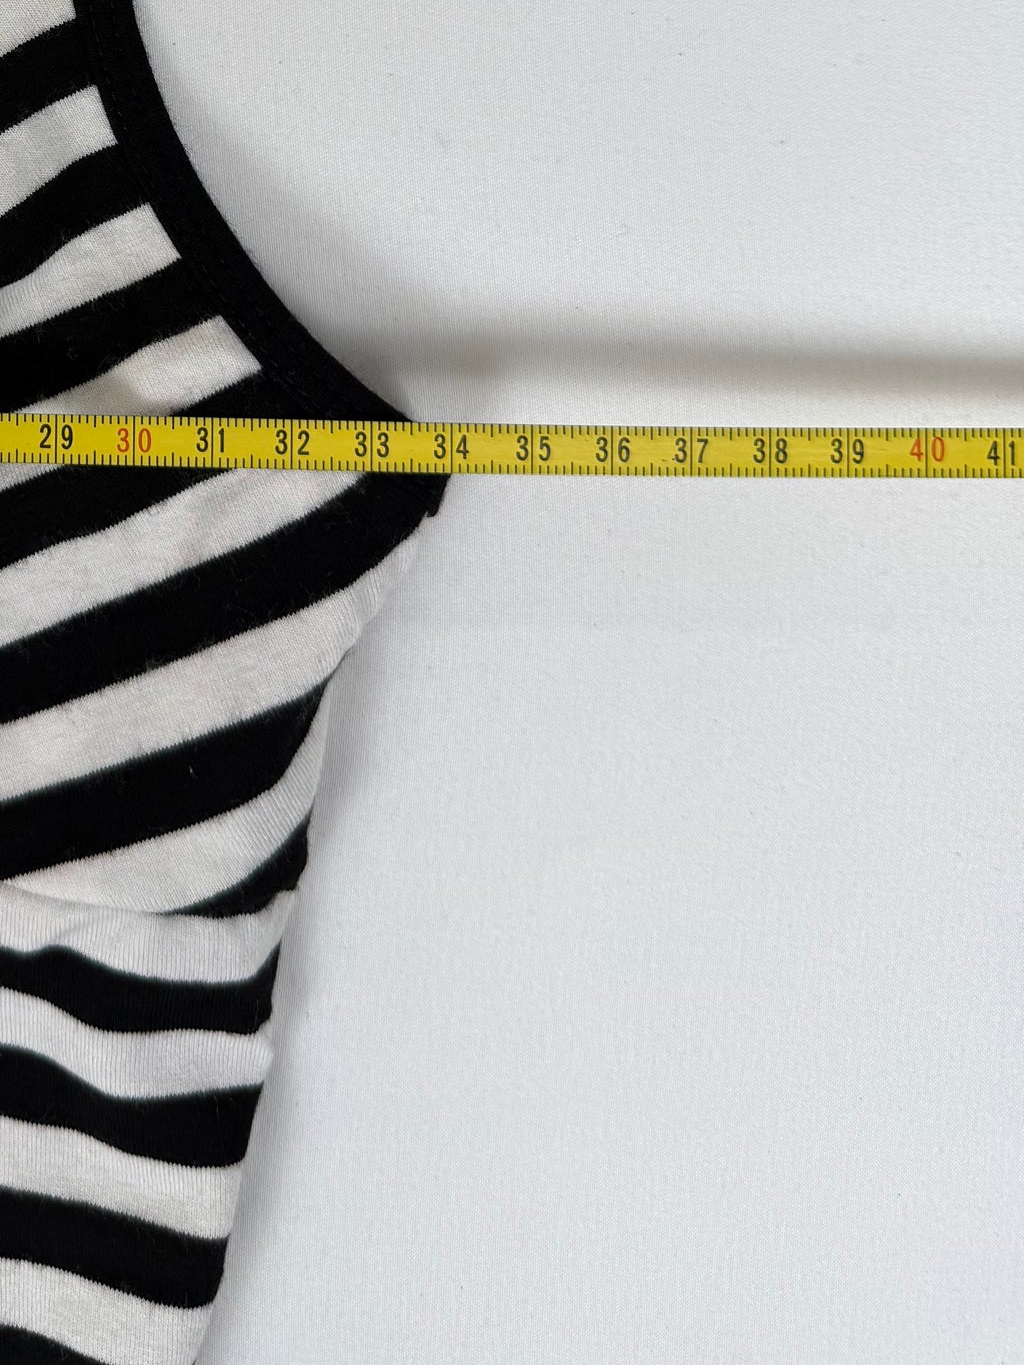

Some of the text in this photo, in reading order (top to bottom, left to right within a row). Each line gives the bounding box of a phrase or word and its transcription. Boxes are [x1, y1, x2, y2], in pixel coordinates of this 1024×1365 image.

[39, 423, 74, 451] 29
[116, 427, 152, 454] 30
[195, 426, 225, 454] 31
[274, 428, 310, 456] 32
[354, 430, 390, 459] 33
[433, 433, 470, 460] 34
[515, 434, 552, 462] 35
[595, 436, 631, 464] 36
[671, 436, 709, 464] 37
[752, 437, 789, 465] 38
[830, 437, 865, 465] 39
[909, 436, 945, 462] 40
[986, 440, 1016, 467] 41
